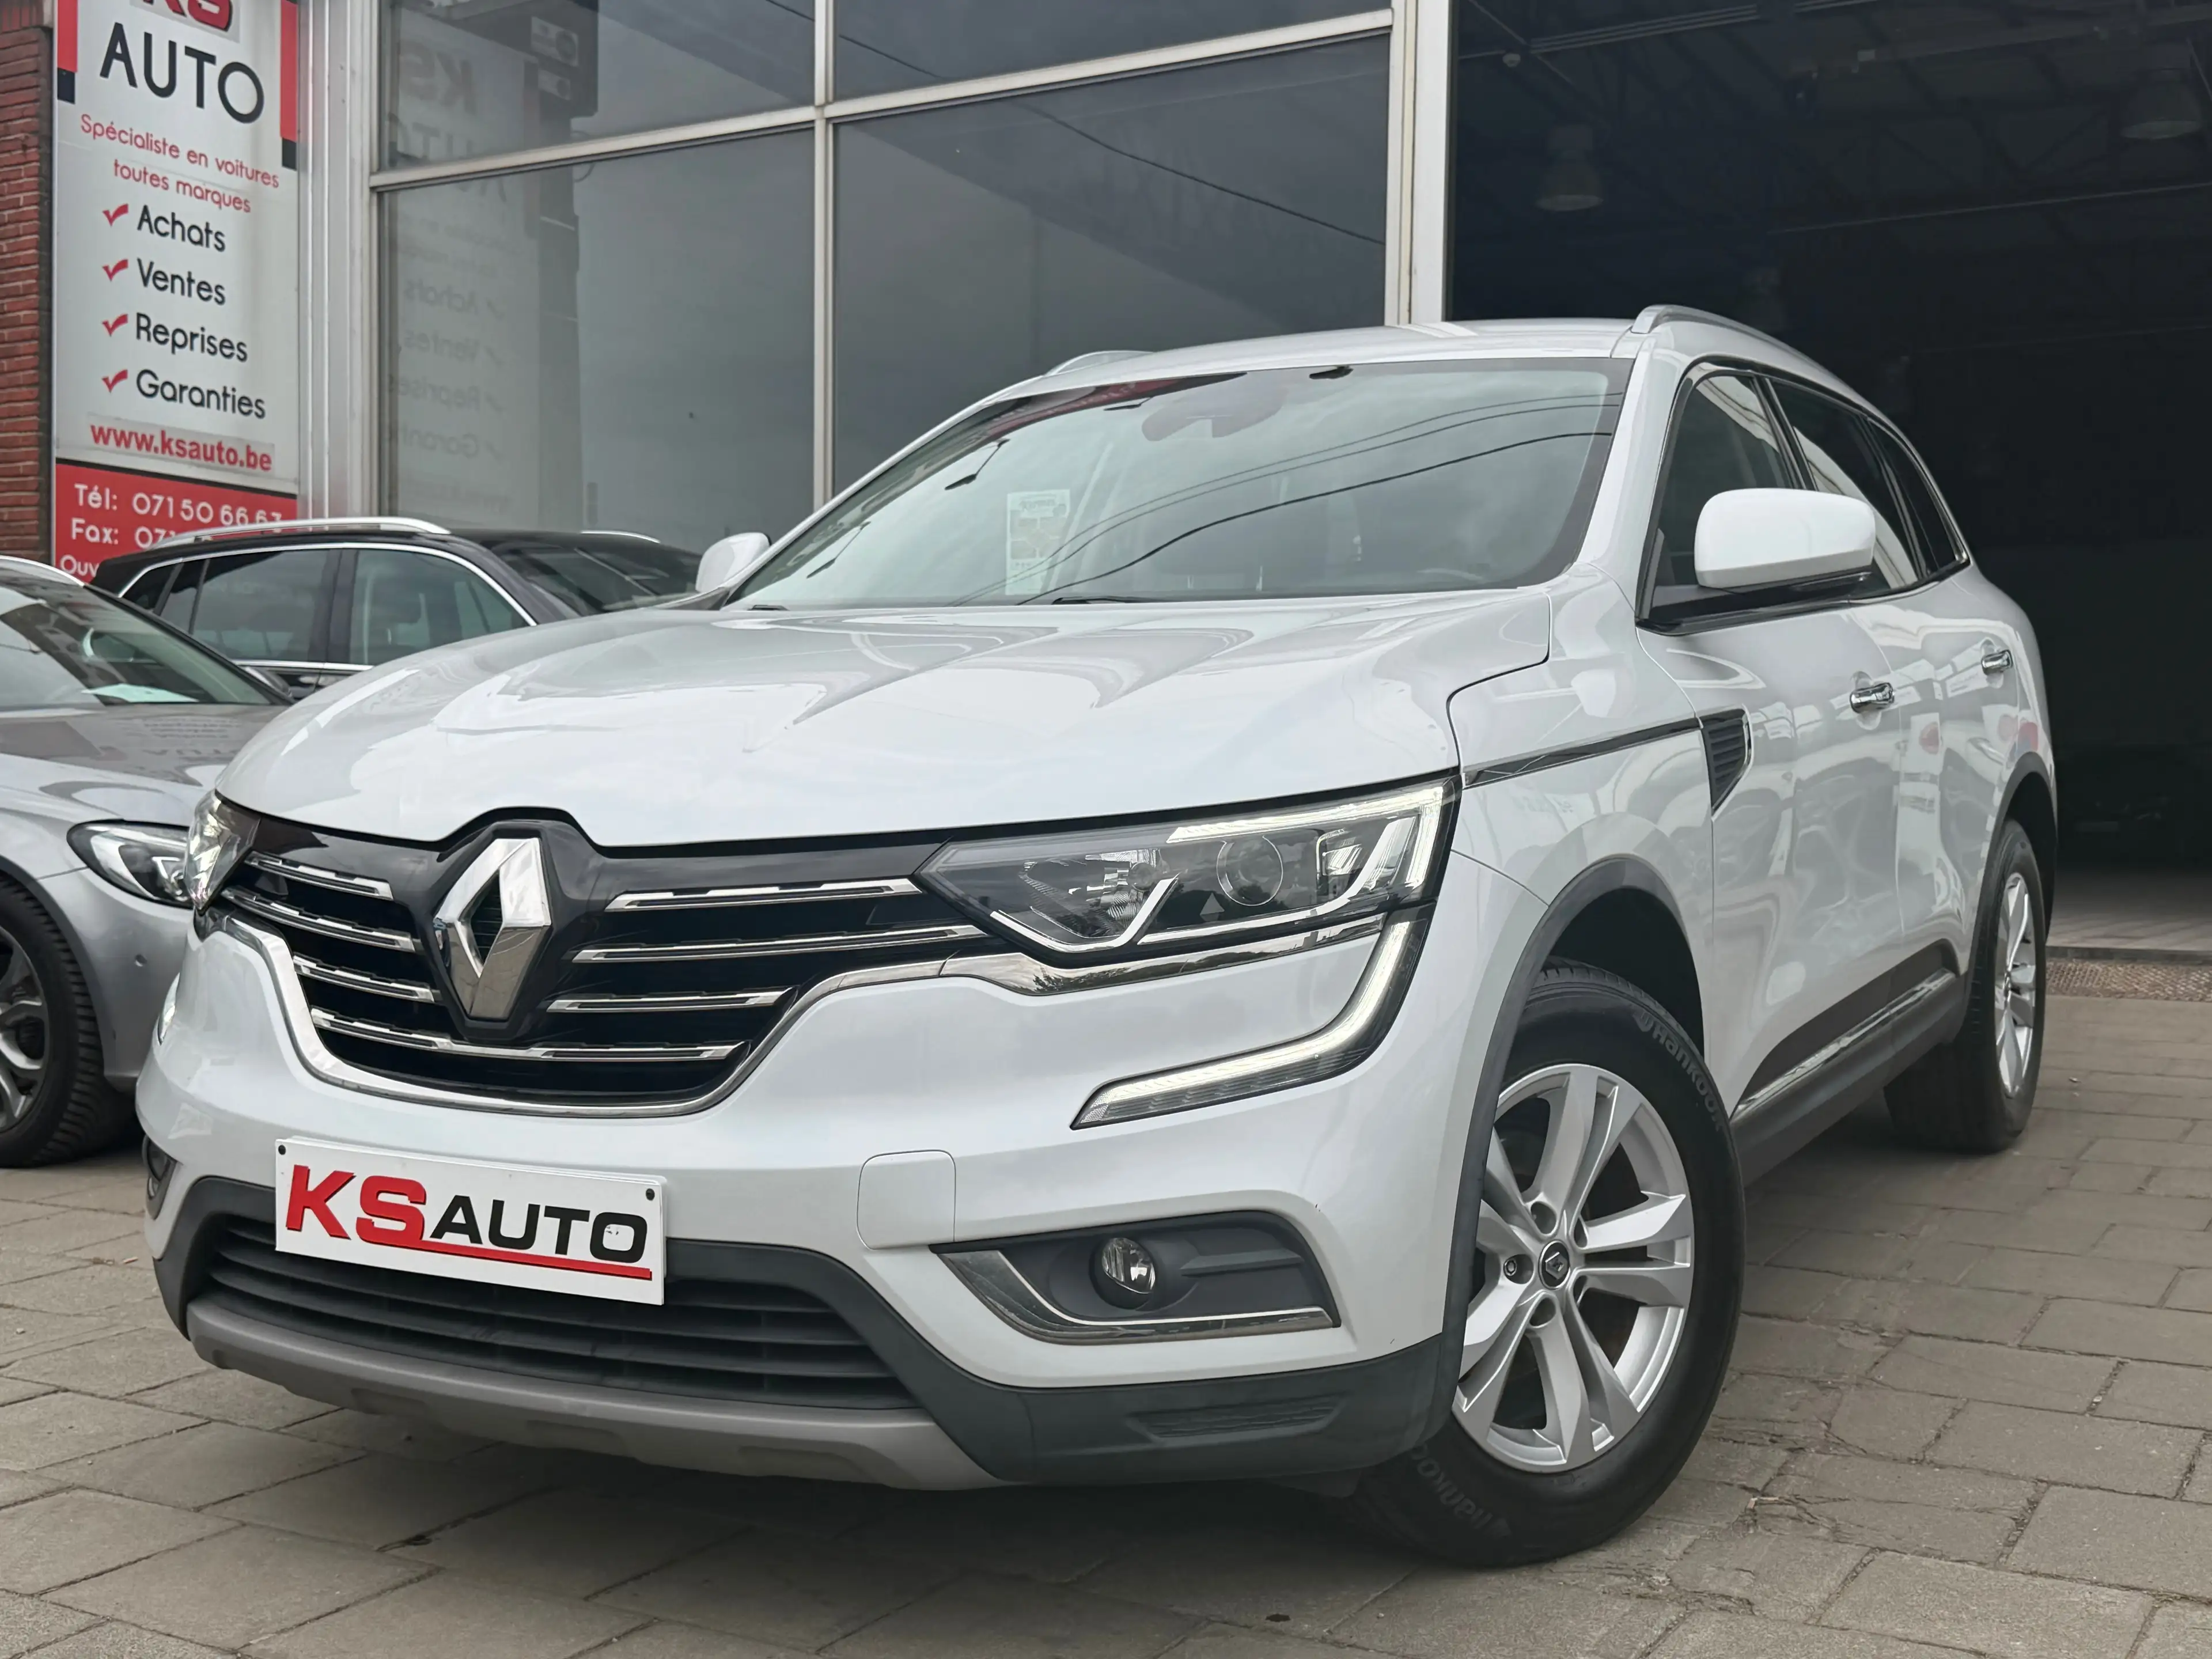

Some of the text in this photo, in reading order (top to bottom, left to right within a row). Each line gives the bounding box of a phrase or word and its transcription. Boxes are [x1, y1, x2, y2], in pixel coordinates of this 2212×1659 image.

[99, 21, 264, 124] AUTO
[81, 113, 279, 188] Spécialiste en voitures
[113, 159, 251, 213] toutes marques
[137, 204, 226, 252] Achats
[137, 257, 226, 306] Ventes
[136, 312, 248, 363] Reprises
[136, 369, 266, 420] Garanties
[90, 424, 272, 472] www.ksauto.be
[74, 483, 118, 511] Tél:
[132, 493, 173, 518] 071
[180, 499, 214, 524] 50
[220, 504, 249, 525] 66
[71, 518, 119, 546] Fax:
[60, 554, 100, 578] Ouv
[286, 1164, 648, 1264] KS AUTO
[1410, 1442, 1494, 1531] Hankoo
